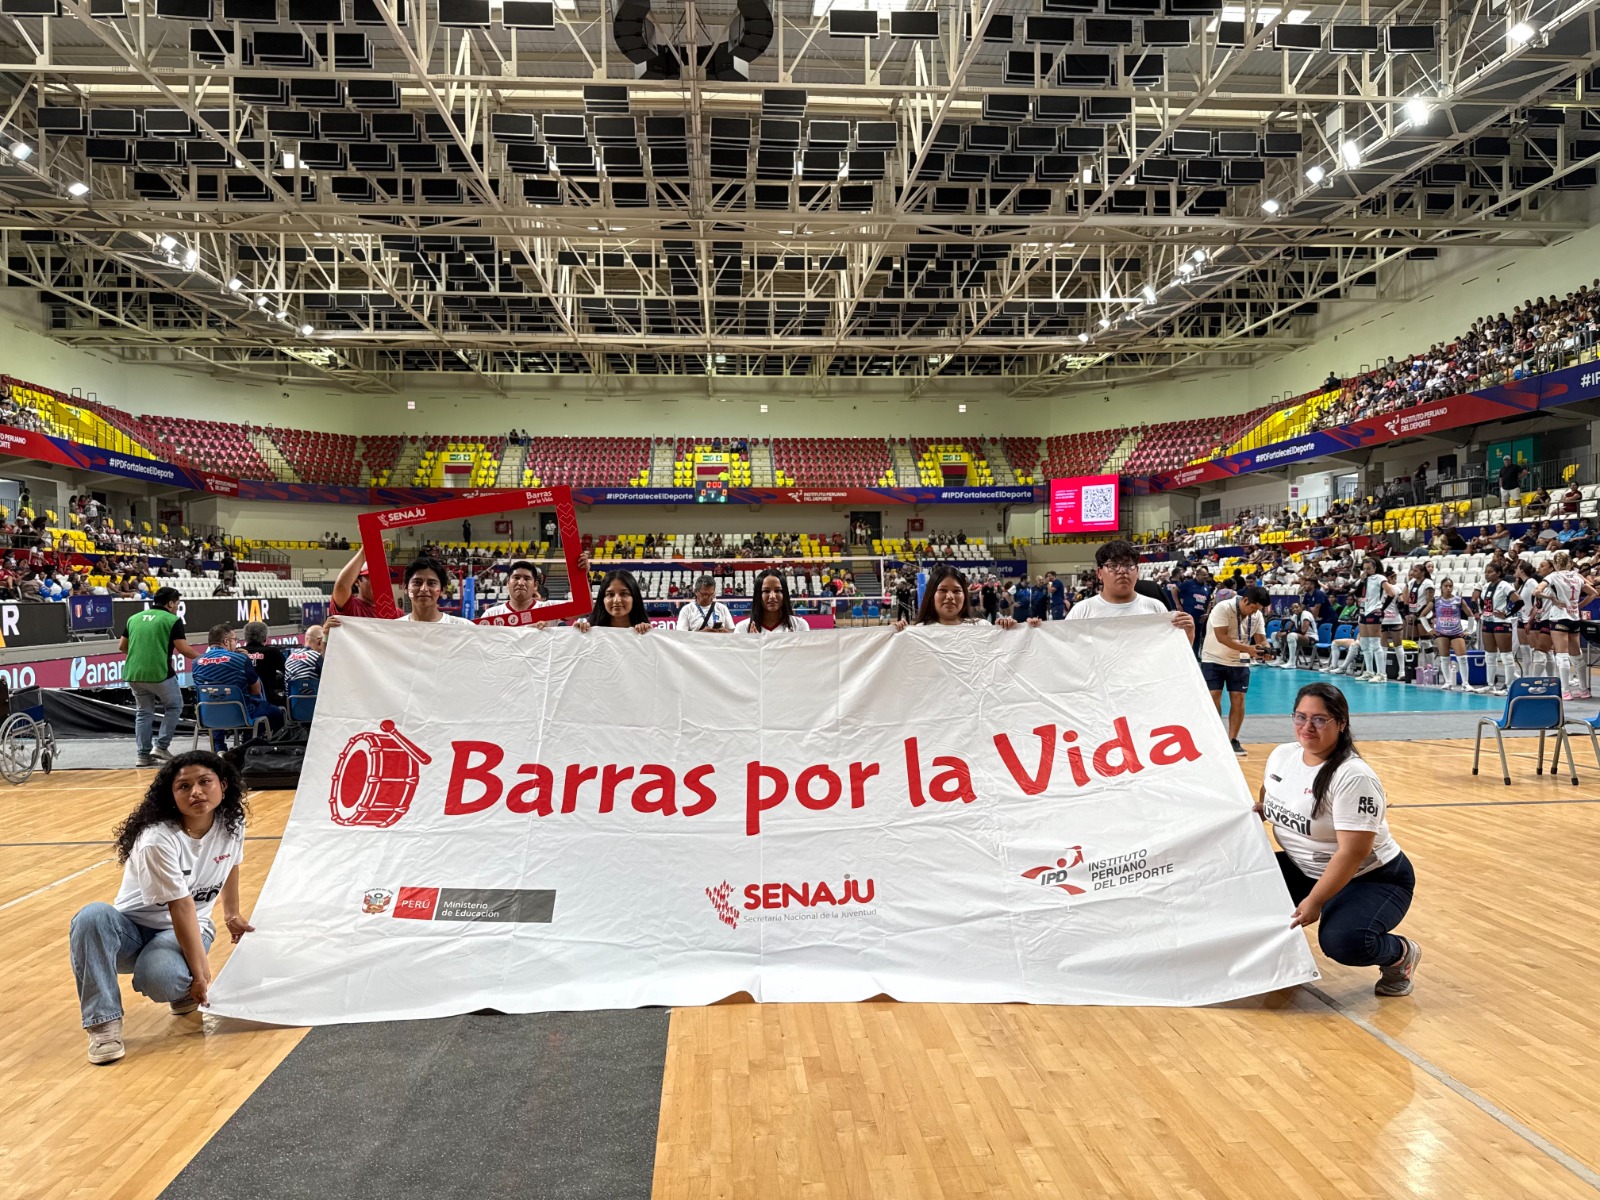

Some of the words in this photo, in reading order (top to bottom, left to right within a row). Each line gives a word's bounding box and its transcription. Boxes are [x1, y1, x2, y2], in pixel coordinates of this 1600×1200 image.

[1401, 412, 1424, 425] INSTITUTO
[1424, 406, 1448, 419] PERUANO
[1410, 418, 1431, 430] DEPORTE
[5, 433, 26, 445] PERUANO
[525, 490, 553, 500] Barras
[606, 493, 693, 501] #IPDFortaleceElDeporte
[941, 490, 1032, 500] #IPDFortaleceElDeporte
[387, 507, 426, 521] SENAJU
[237, 599, 269, 622] MAR
[444, 741, 716, 816] Barras
[746, 761, 880, 836] por
[904, 737, 976, 807] la
[994, 717, 1201, 795] Vida
[1358, 796, 1374, 806] RE
[1088, 848, 1147, 872] INSTITUTO
[1091, 858, 1147, 882] PERUANO
[1040, 869, 1068, 886] IPD
[1094, 879, 1116, 891] DEL
[1119, 863, 1174, 886] DEPORTE
[744, 873, 875, 910] SENAJU
[401, 898, 431, 909] PERÚ
[443, 901, 488, 910] Ministerio
[441, 909, 453, 917] de
[455, 909, 500, 919] Educación
[784, 912, 819, 921] Nacional
[820, 911, 831, 919] de
[832, 910, 839, 919] la
[841, 908, 877, 918] Juventud
